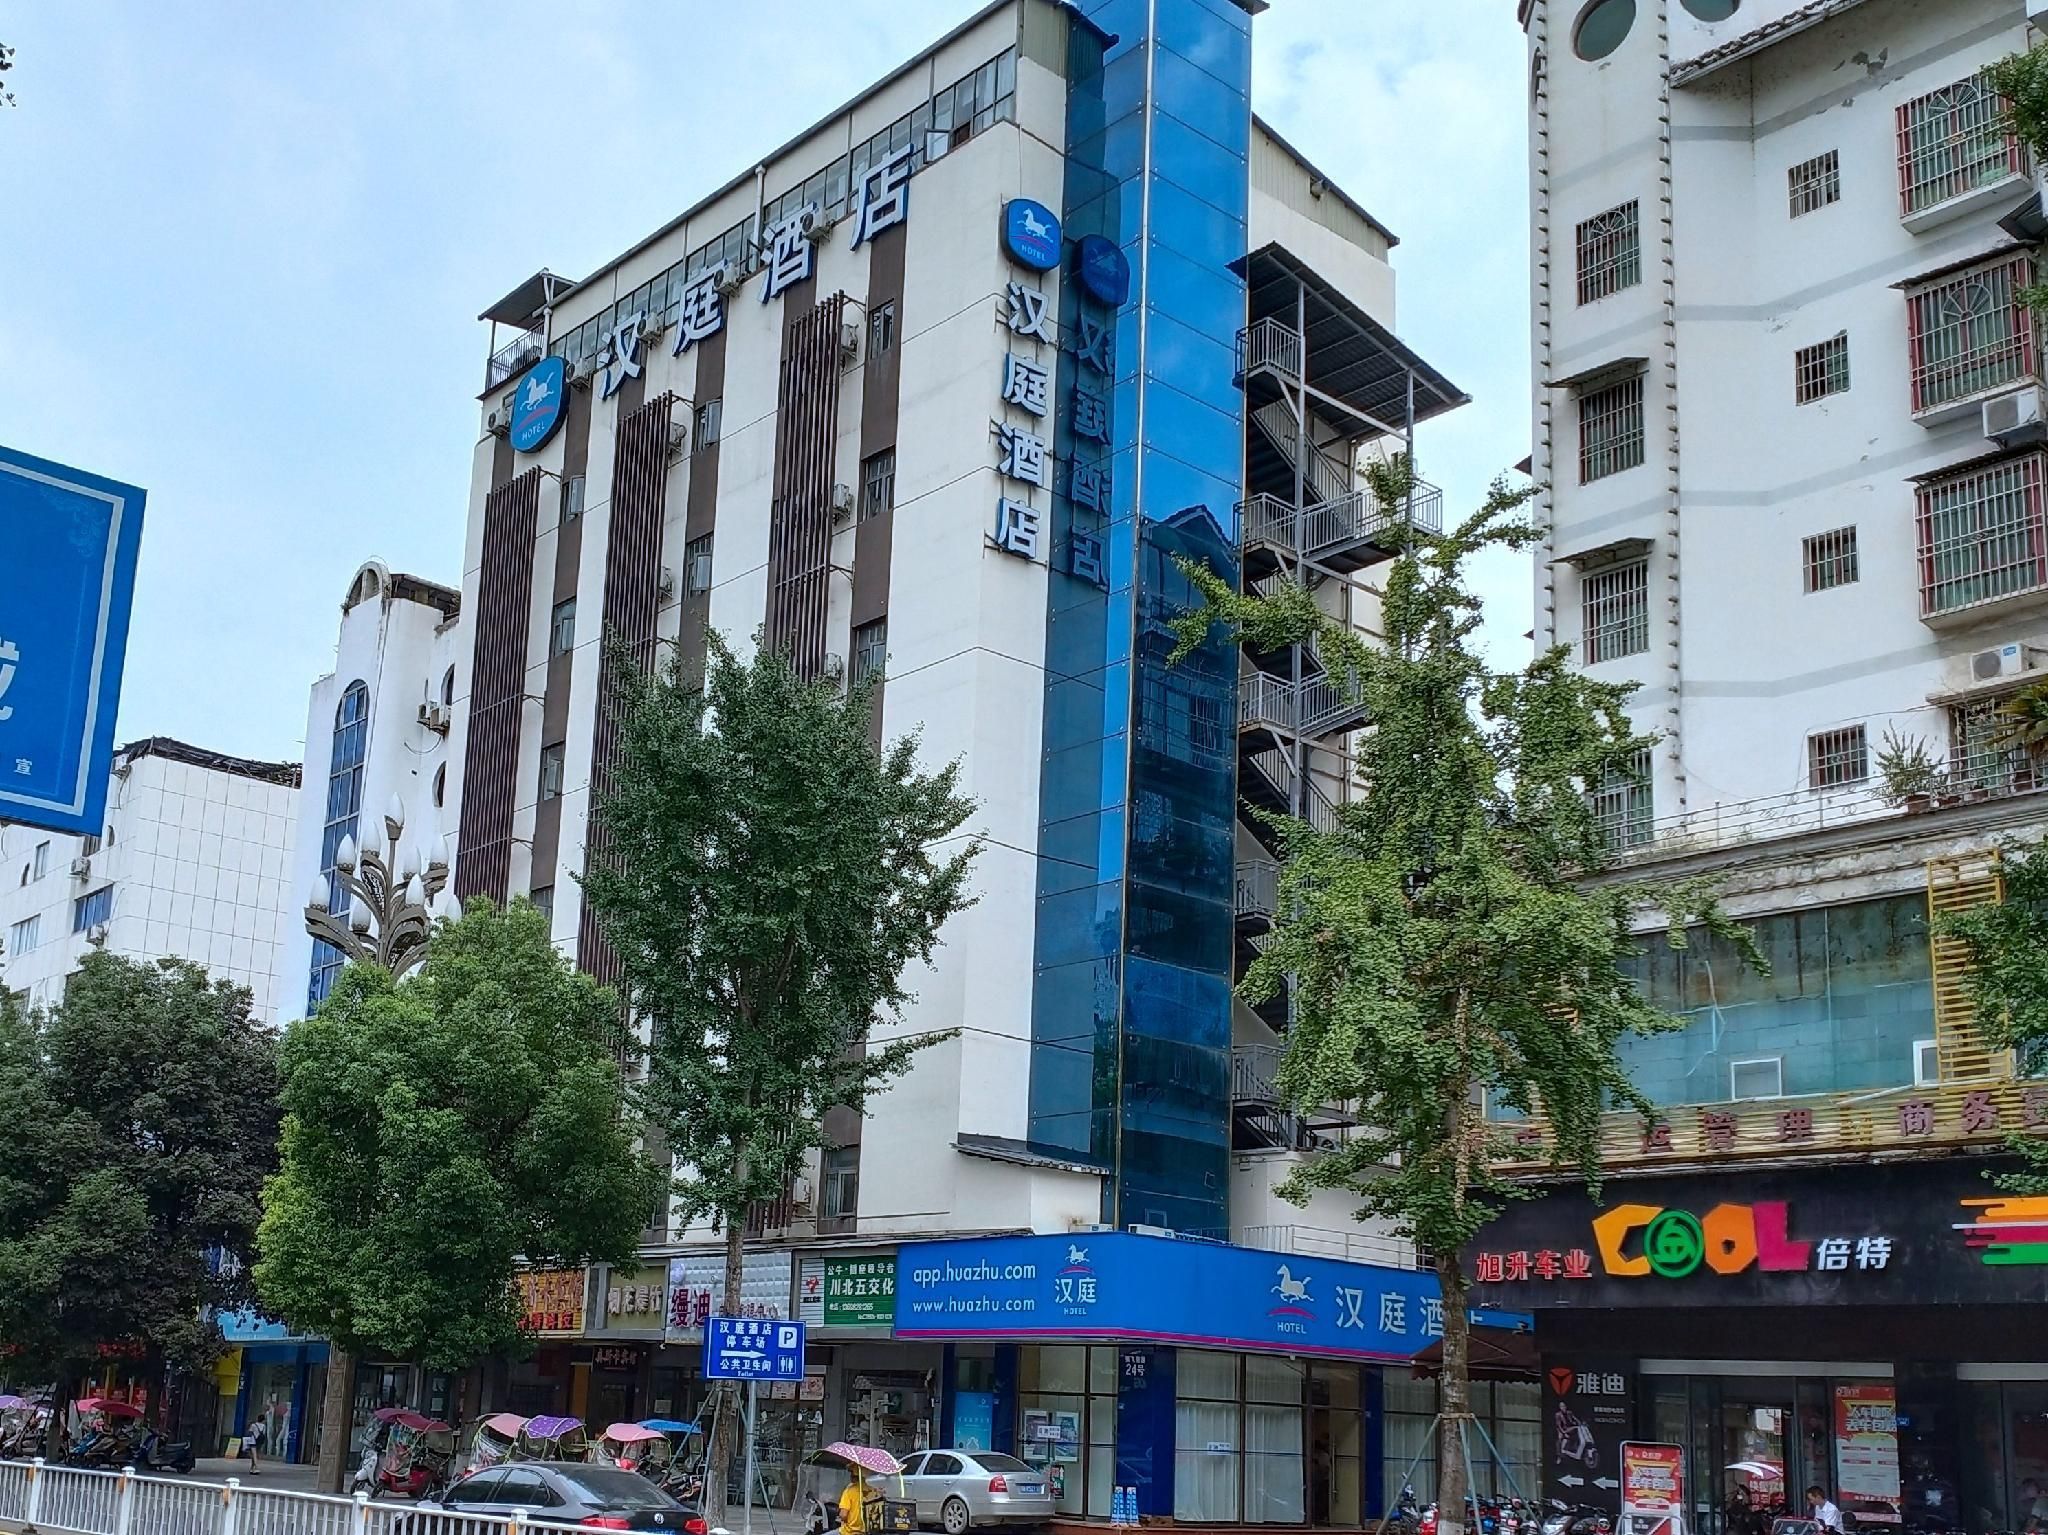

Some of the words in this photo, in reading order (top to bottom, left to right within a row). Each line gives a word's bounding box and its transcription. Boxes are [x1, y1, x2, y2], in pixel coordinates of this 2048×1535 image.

[1021, 244, 1046, 261] HOTEL
[597, 144, 914, 401] 汉庭酒店
[996, 281, 1051, 560] 汉庭酒店
[521, 424, 546, 441] HOTEL
[1816, 1236, 1893, 1271] 倍特
[913, 1258, 1037, 1289] app.huazhu.com
[1475, 1248, 1593, 1283] 旭升车业
[829, 1277, 895, 1296] 川北五交化
[1054, 1277, 1097, 1304] 汉庭
[912, 1295, 1036, 1313] www.huazhu.com
[1063, 1307, 1088, 1315] HOTEL
[1335, 1285, 1483, 1337] 汉庭酒
[719, 1321, 772, 1335] 汉庭酒店
[1276, 1321, 1307, 1334] HOTEL
[726, 1335, 766, 1349] 停车场
[783, 1331, 794, 1345] P
[720, 1358, 772, 1372] 公共卫生间
[1125, 1363, 1145, 1377] 24号
[1575, 1372, 1626, 1395] 雅迪
